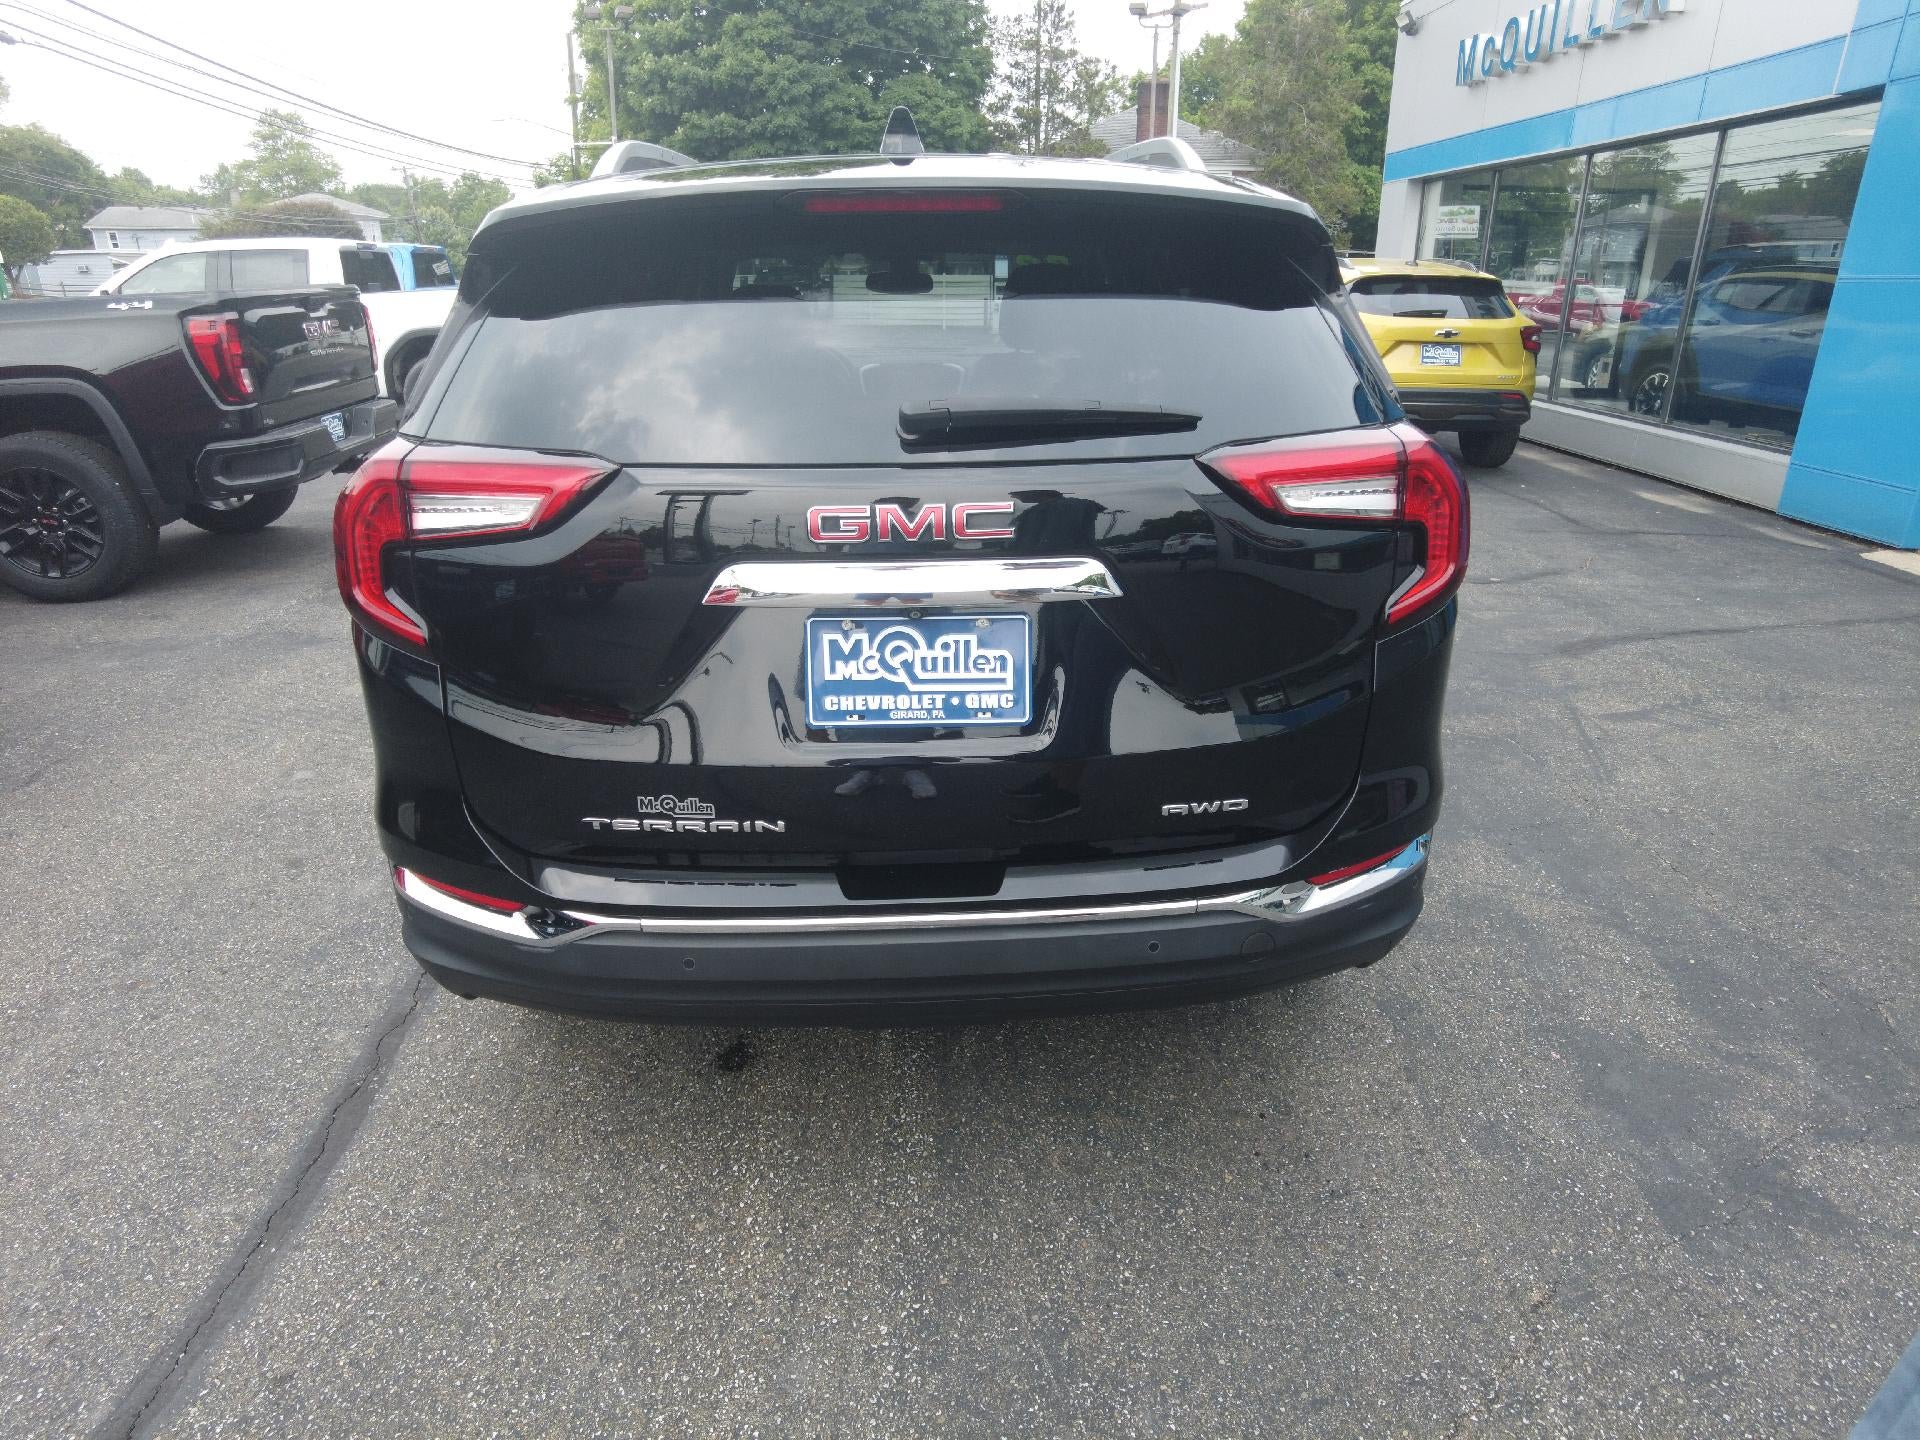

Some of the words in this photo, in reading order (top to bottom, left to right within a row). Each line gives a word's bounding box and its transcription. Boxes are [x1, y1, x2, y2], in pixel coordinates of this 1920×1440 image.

[806, 501, 1015, 544] GMC
[822, 625, 1015, 692] McQuillen
[824, 694, 946, 711] CHEVROLET
[965, 693, 1015, 709] GMC
[889, 710, 930, 720] GIRARD,
[932, 710, 946, 719] PA
[637, 794, 715, 818] McQuillen
[1161, 798, 1249, 817] AWD
[581, 817, 786, 833] TERRAIN
